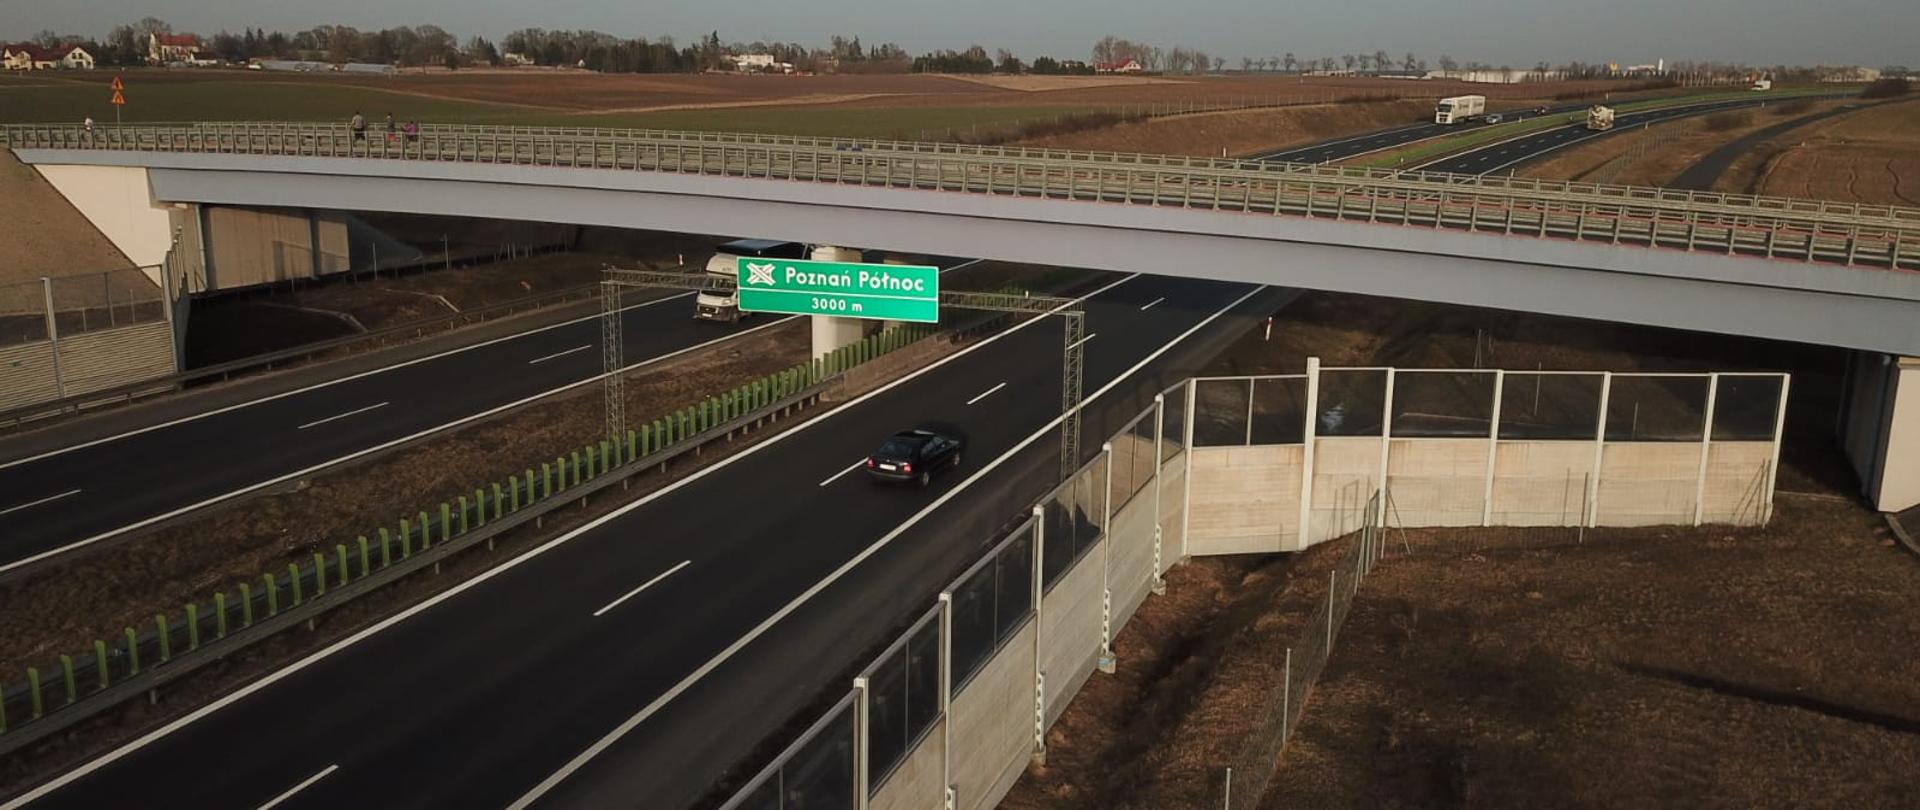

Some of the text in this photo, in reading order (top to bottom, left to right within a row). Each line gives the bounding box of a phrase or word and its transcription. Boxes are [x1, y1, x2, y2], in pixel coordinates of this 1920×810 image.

[785, 267, 924, 291] Poznań Północ
[812, 298, 863, 312] 3000 m
